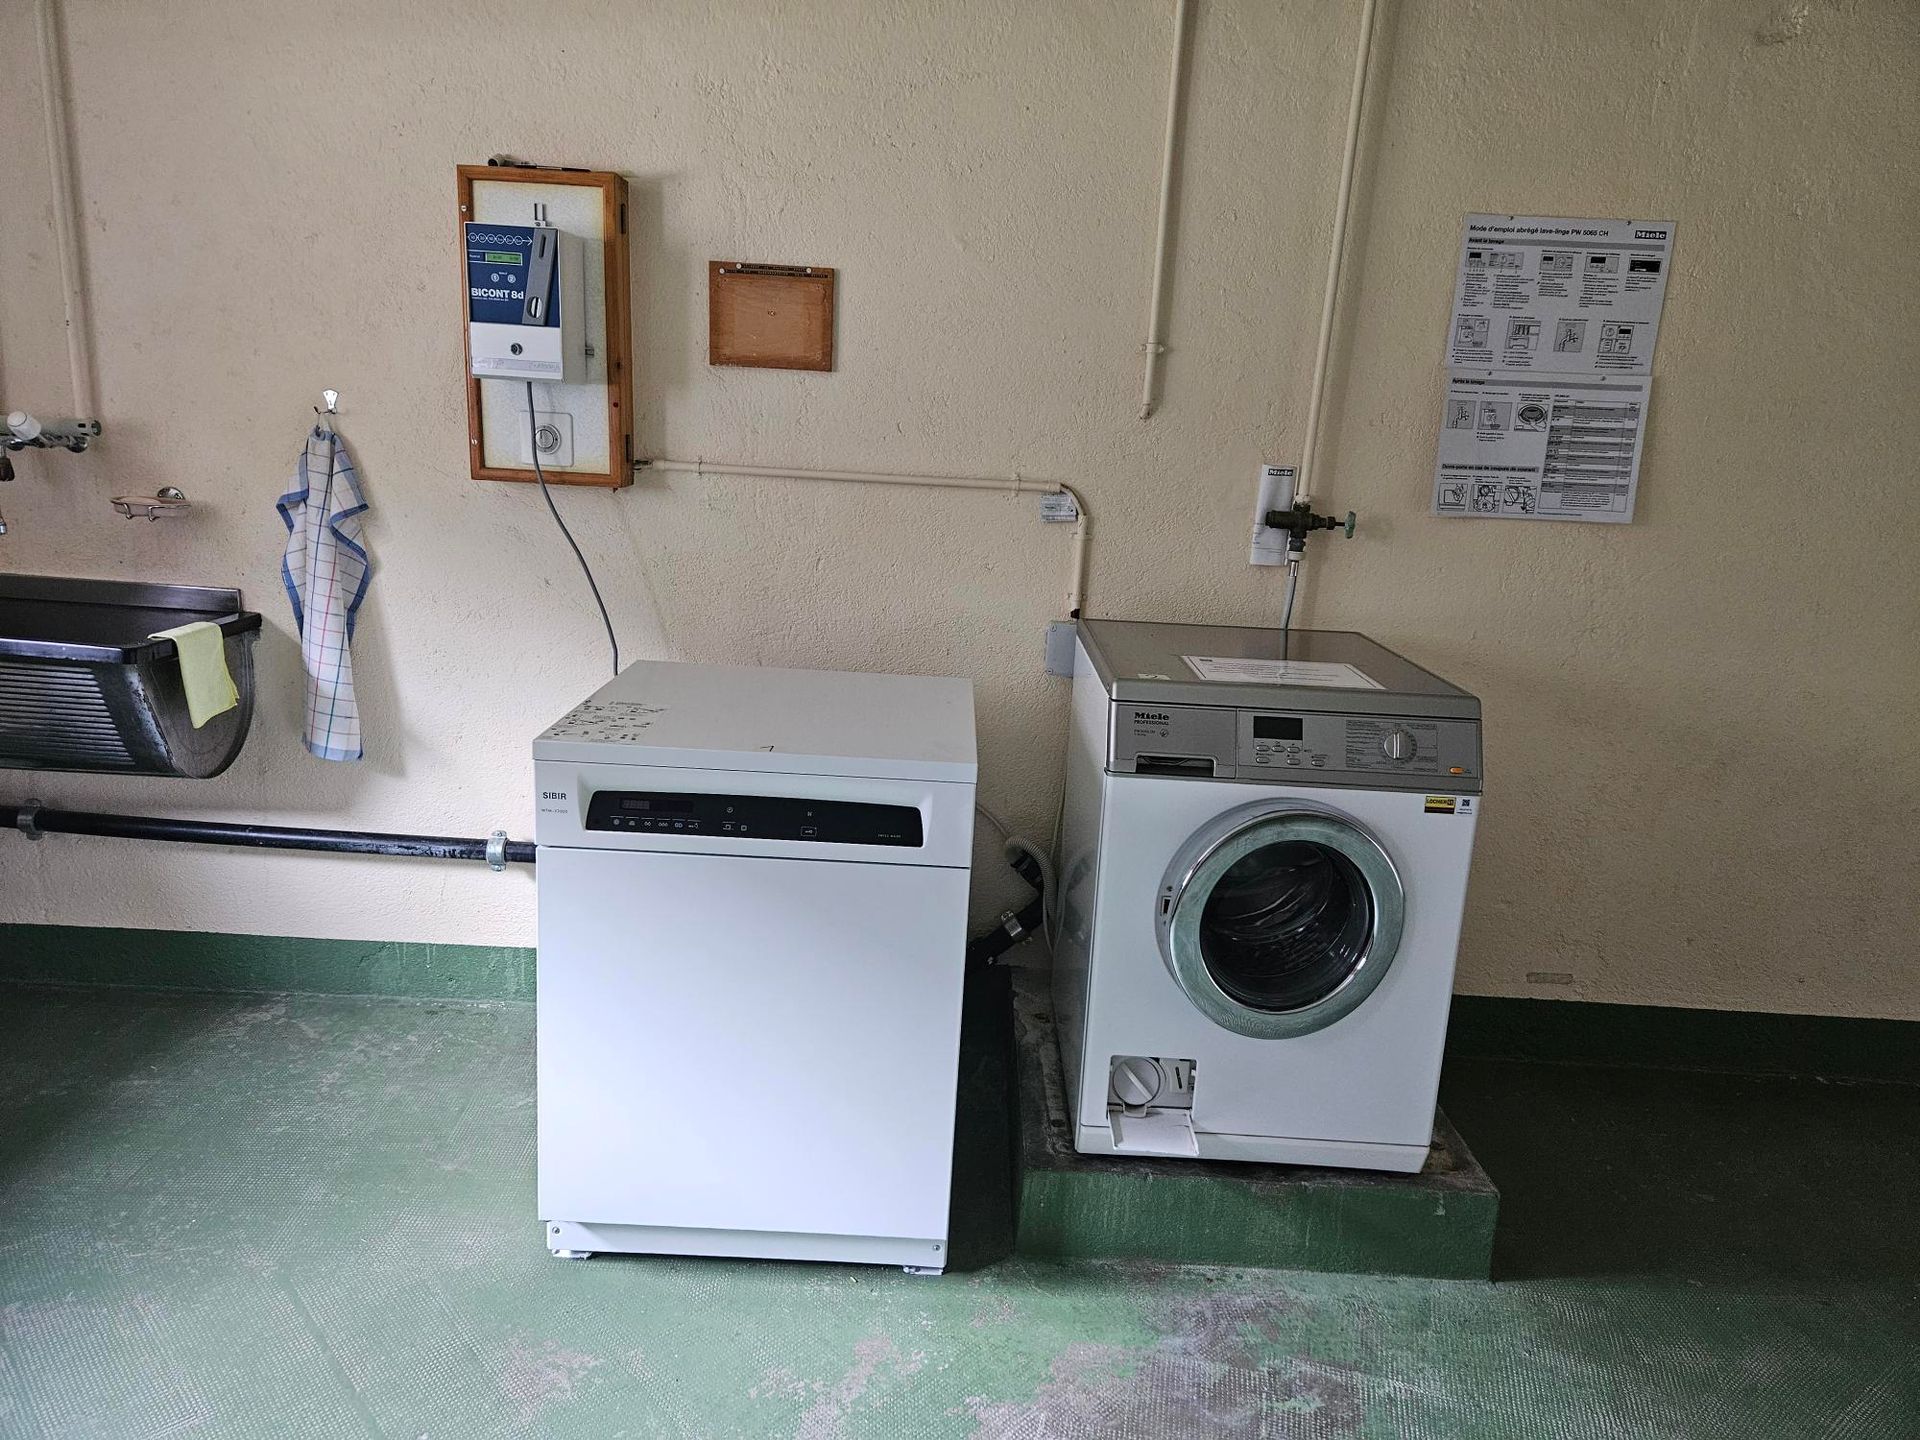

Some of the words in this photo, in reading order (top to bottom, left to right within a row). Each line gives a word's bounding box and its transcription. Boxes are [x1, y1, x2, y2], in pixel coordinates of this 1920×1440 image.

[1469, 224, 1487, 232] Mode
[1488, 225, 1515, 234] d'emploi
[1516, 227, 1539, 235] abrégé
[1539, 227, 1570, 236] lave-linge
[1635, 230, 1667, 240] Miele
[471, 288, 510, 299] BICONT
[511, 290, 524, 300] 8d
[1135, 711, 1169, 720] Miele
[542, 791, 567, 801] SIBIR
